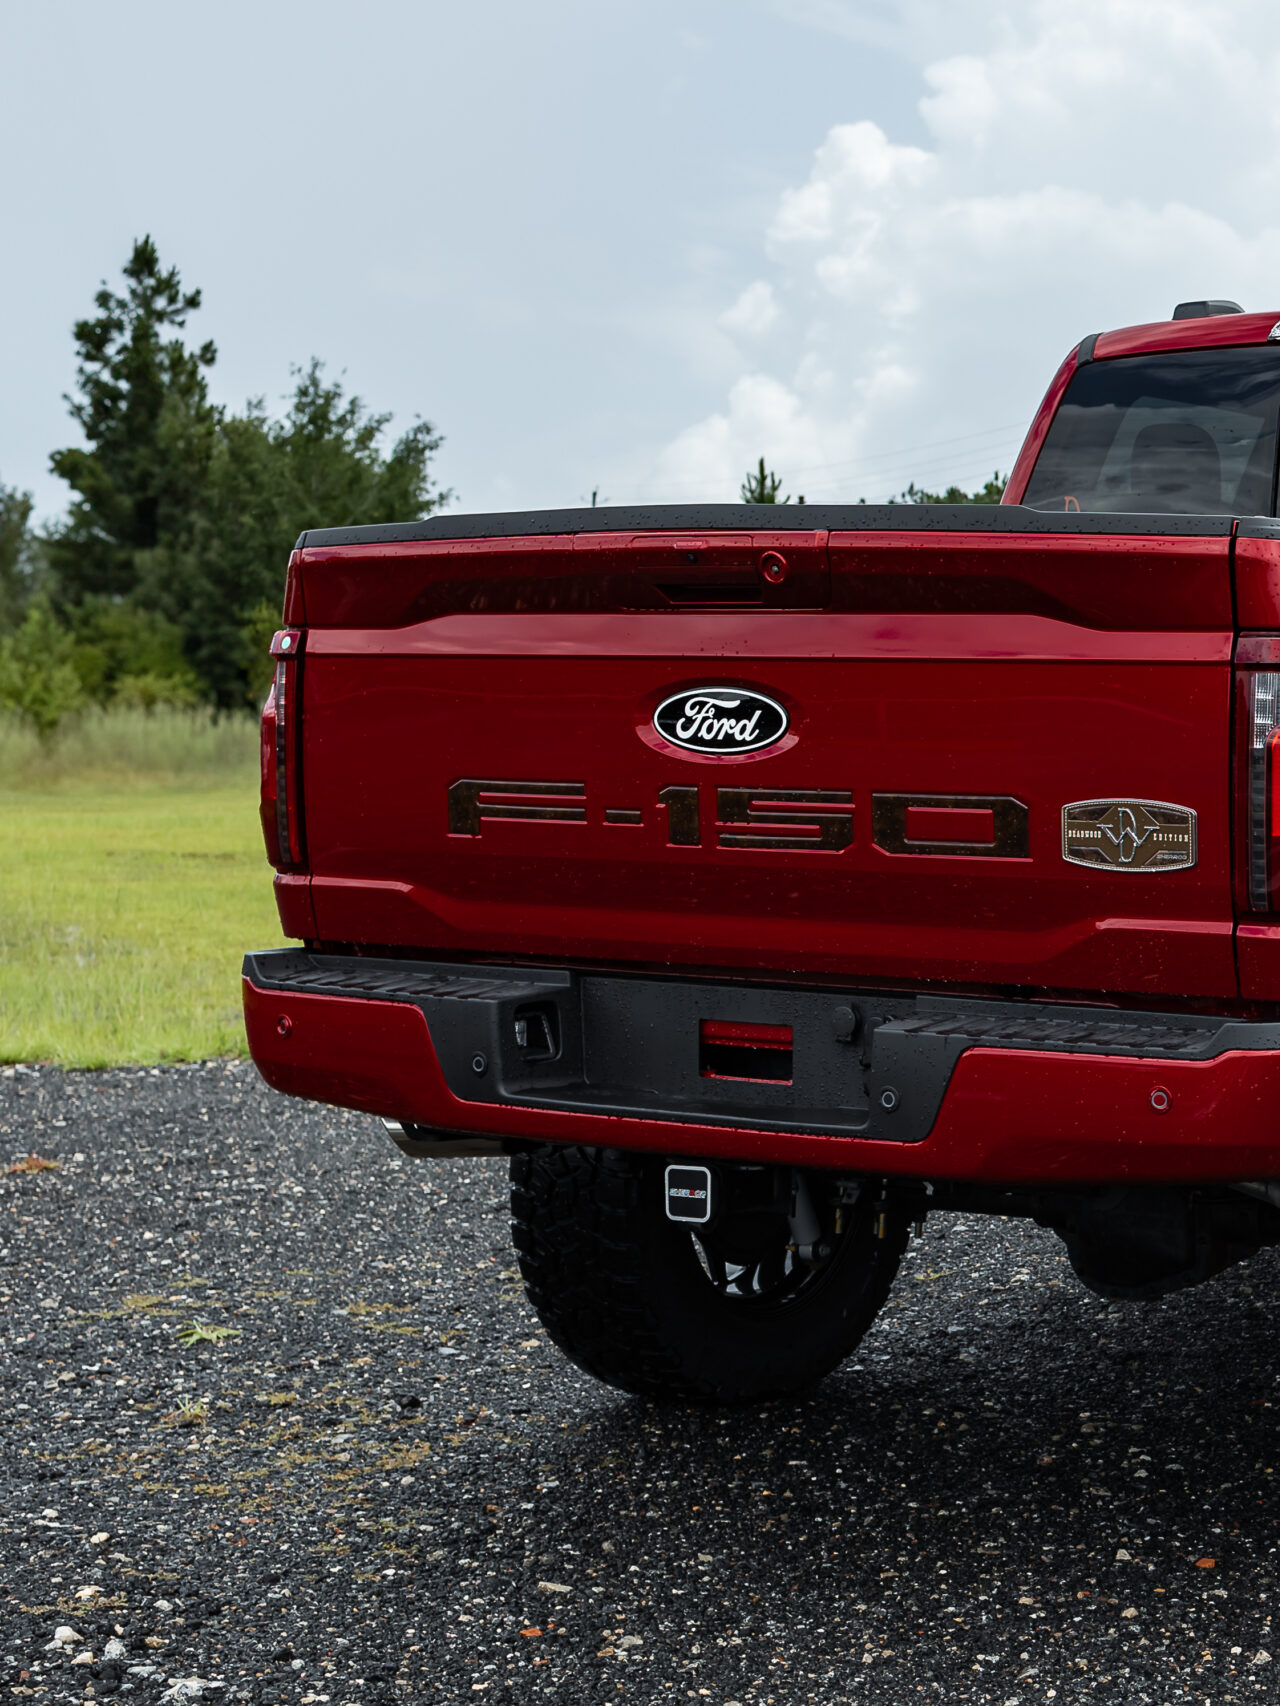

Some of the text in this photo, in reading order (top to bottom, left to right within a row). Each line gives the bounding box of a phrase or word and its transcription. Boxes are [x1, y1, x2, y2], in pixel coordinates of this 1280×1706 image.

[676, 697, 762, 741] Ford
[448, 779, 1033, 861] F-150
[1153, 832, 1189, 843] EDITION
